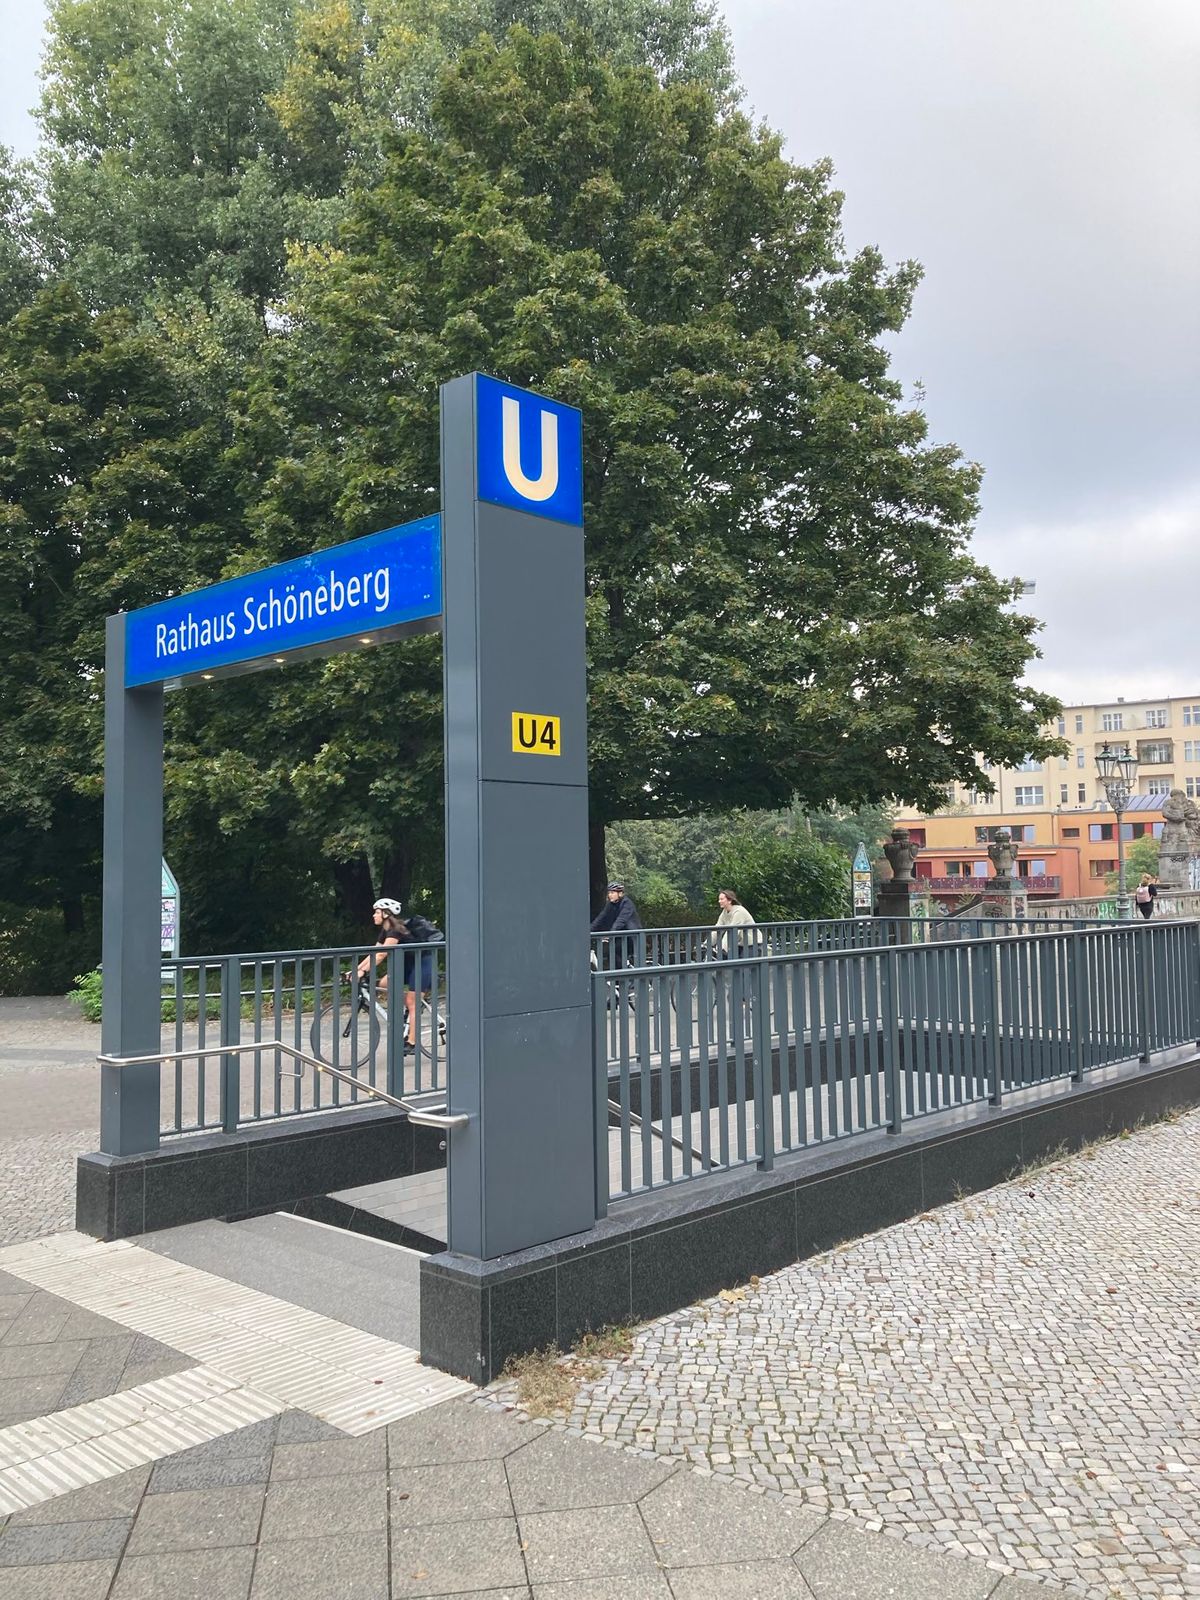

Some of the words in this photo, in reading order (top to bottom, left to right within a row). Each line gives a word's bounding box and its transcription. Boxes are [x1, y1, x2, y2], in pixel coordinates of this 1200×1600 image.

[502, 396, 559, 502] U
[155, 611, 236, 658] Rathaus
[242, 567, 391, 635] Schöneberg
[518, 718, 556, 750] U4
